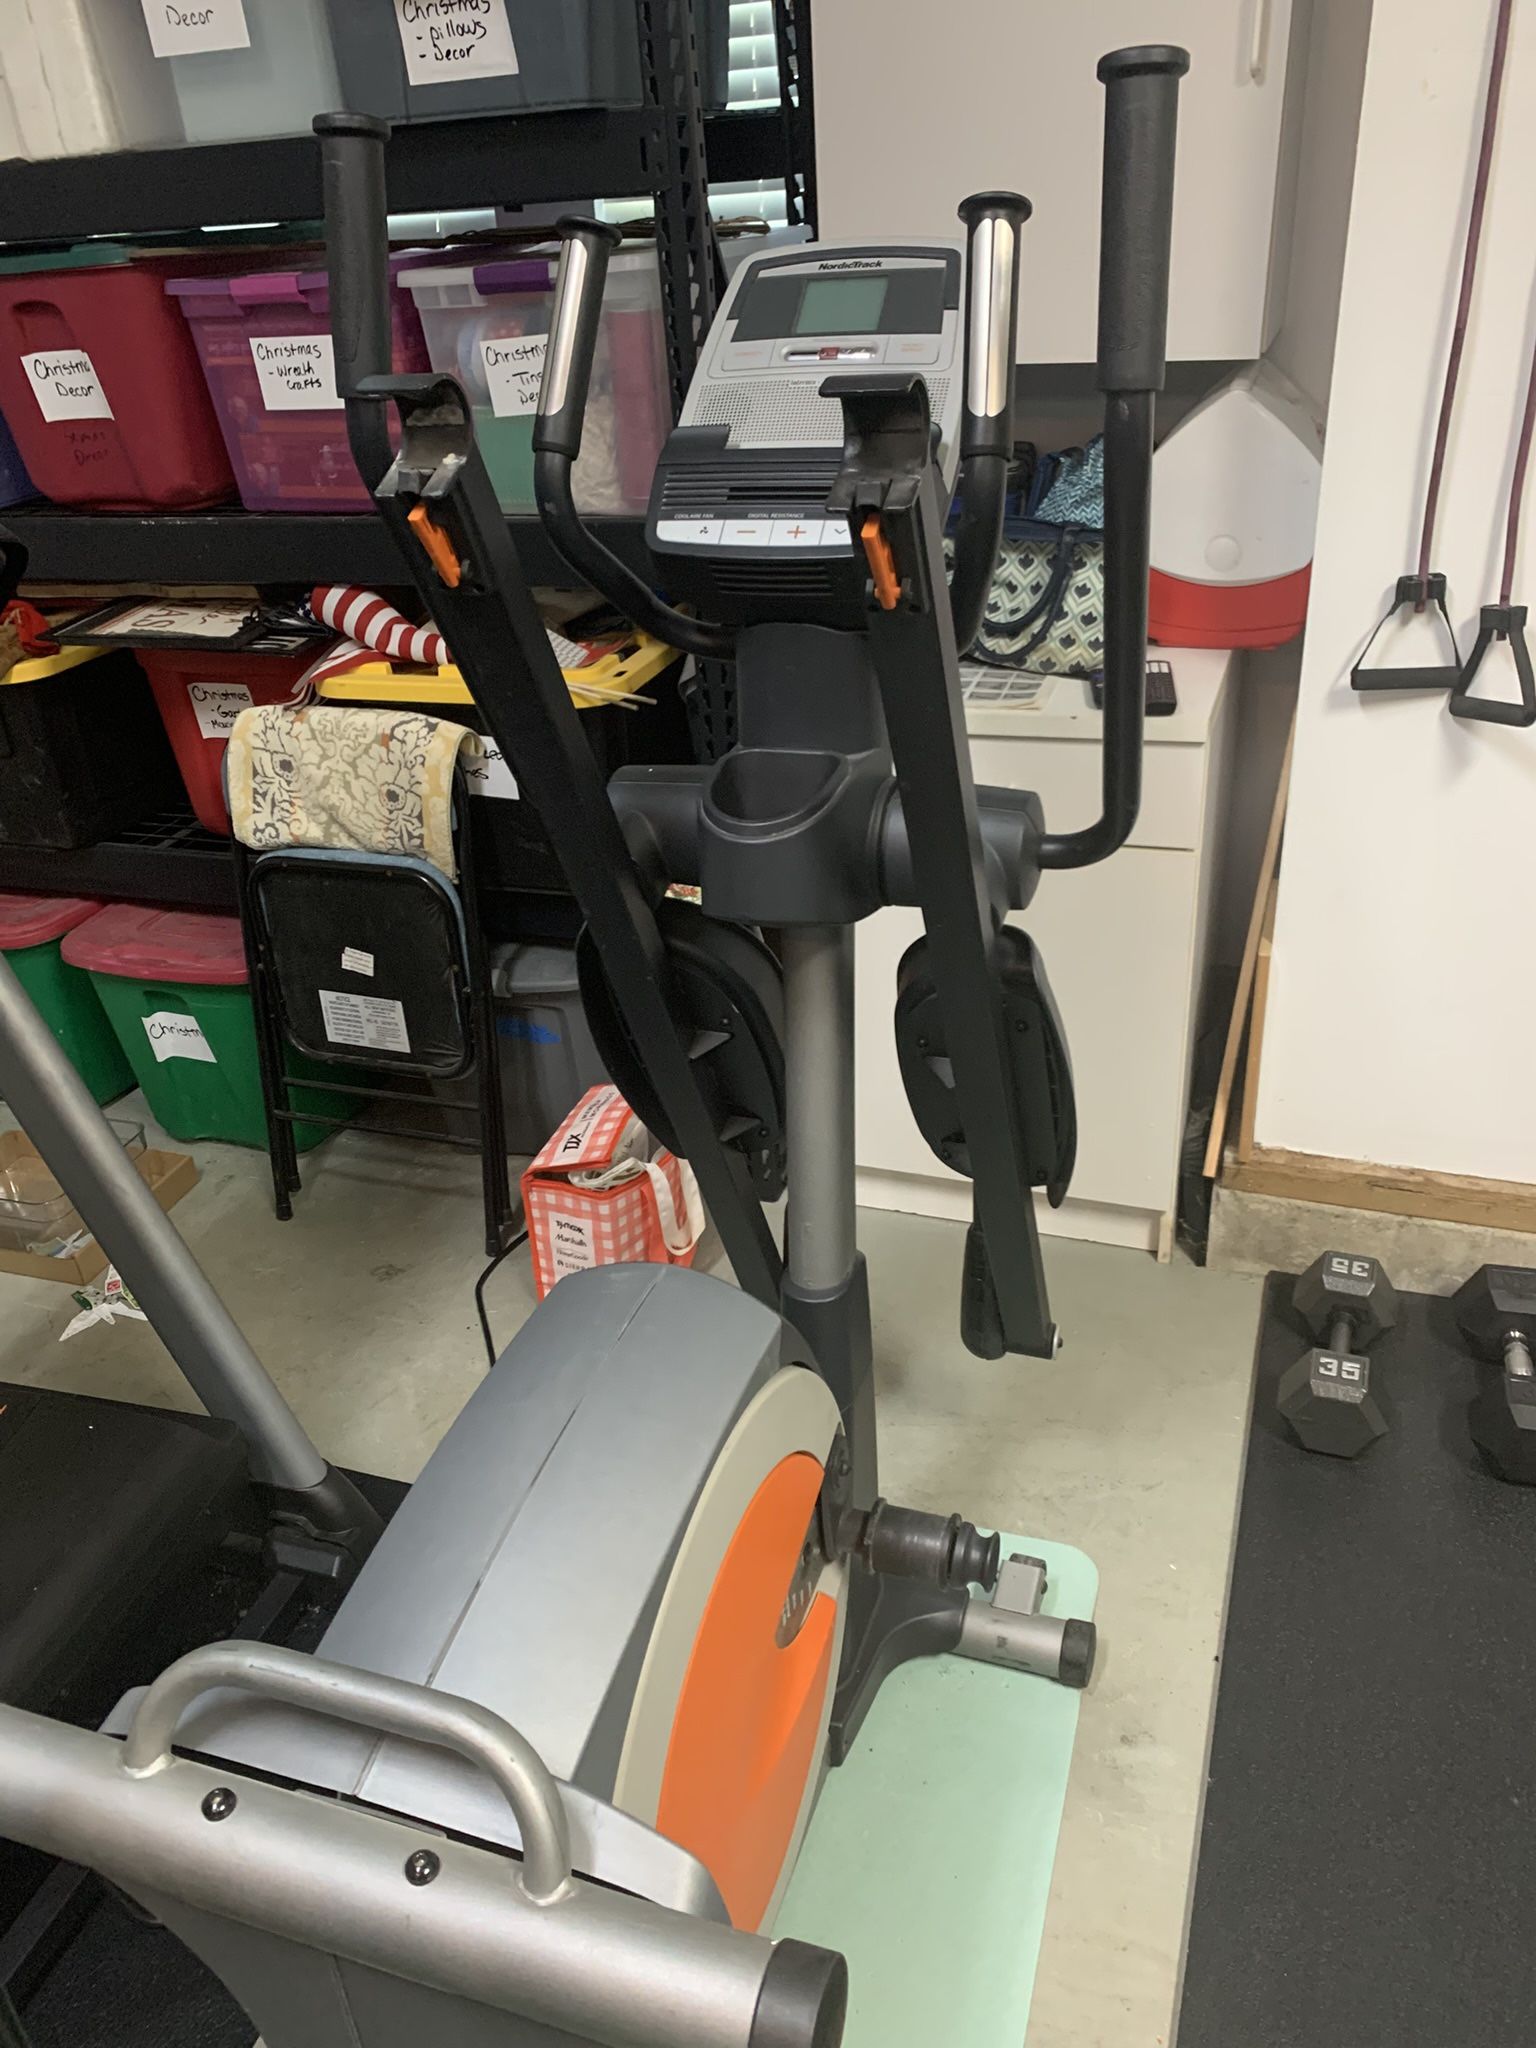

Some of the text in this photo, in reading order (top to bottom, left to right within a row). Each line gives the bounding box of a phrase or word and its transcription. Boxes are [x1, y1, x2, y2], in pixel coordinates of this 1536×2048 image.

[166, 5, 213, 26] Decor
[818, 260, 883, 270] NordicTrack
[257, 343, 322, 360] Christmas
[55, 382, 94, 397] Decor
[191, 685, 250, 702] Christmas
[1331, 1257, 1370, 1278] 35
[1318, 1356, 1361, 1381] 35
